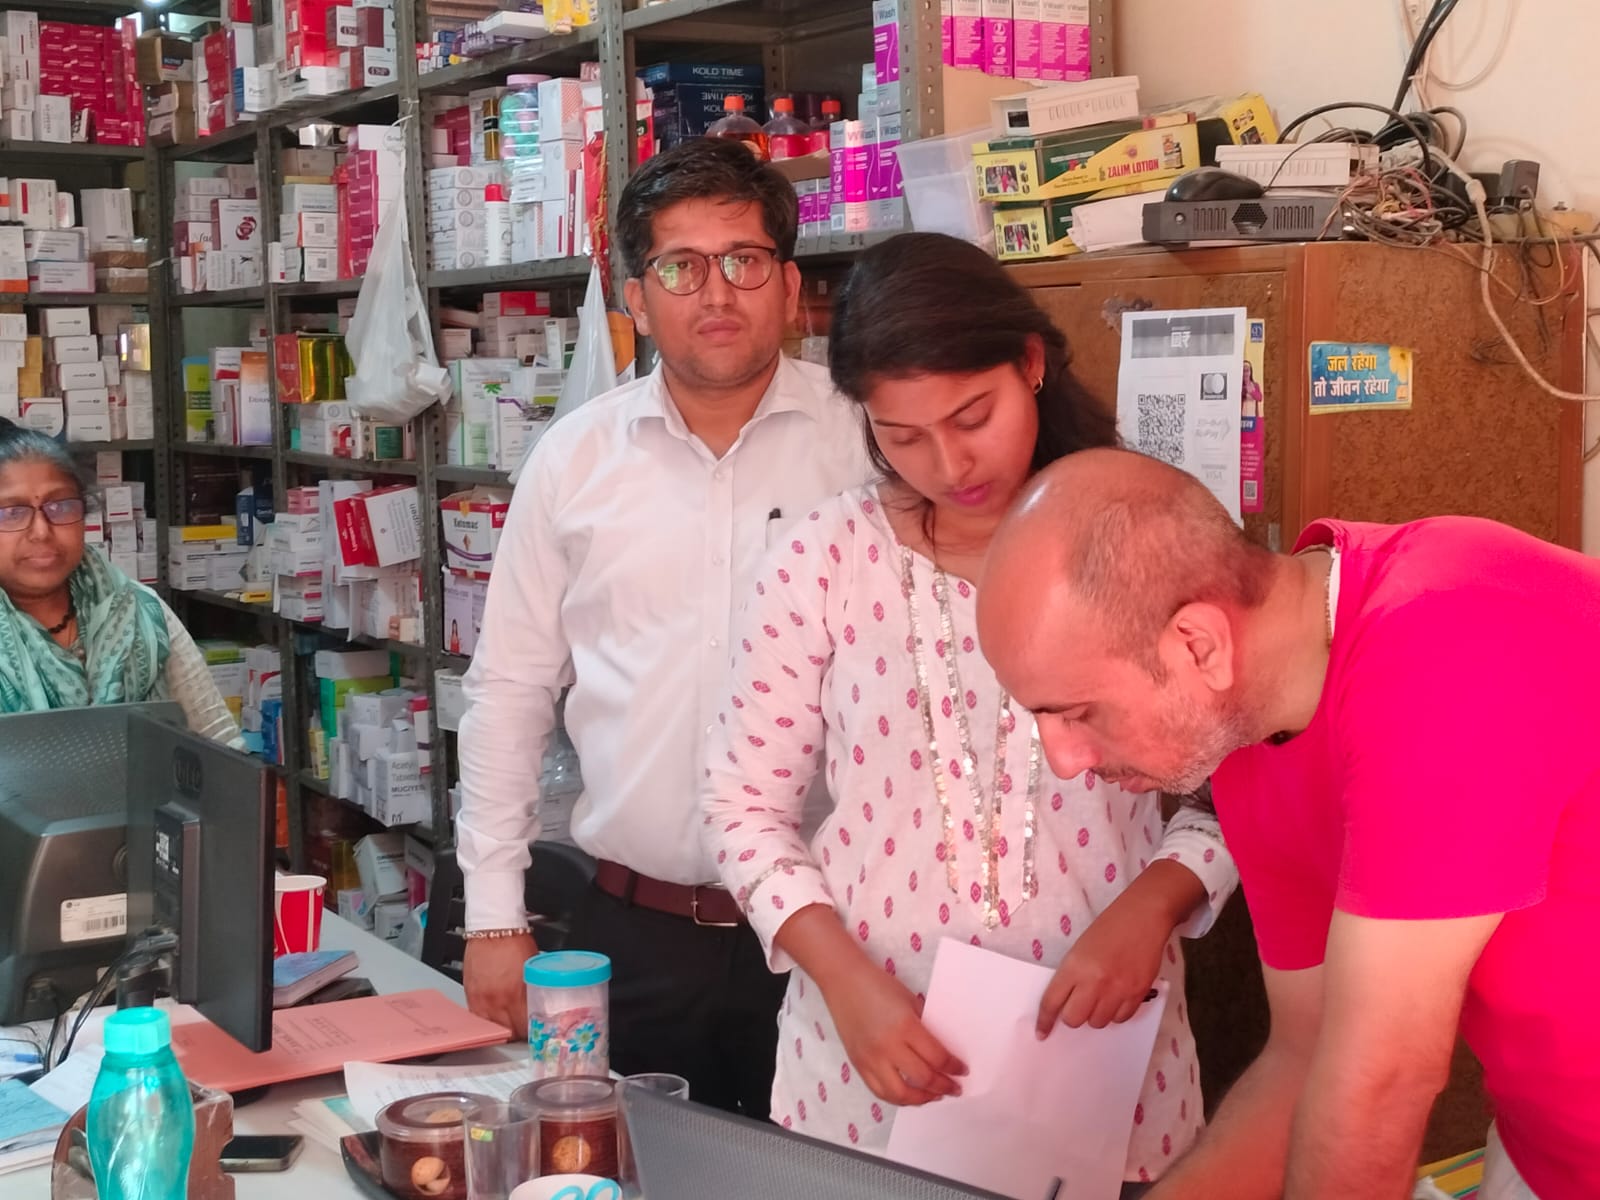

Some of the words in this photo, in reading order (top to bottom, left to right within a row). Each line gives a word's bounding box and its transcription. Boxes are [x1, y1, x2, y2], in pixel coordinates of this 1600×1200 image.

[692, 66, 719, 76] KOLD
[722, 68, 744, 76] TIME
[1108, 163, 1131, 178] ZALIM
[1132, 159, 1159, 173] LOTION
[1327, 354, 1348, 372] जल
[1351, 351, 1377, 371] रहेगा
[1313, 377, 1327, 398] तो
[1329, 376, 1361, 397] जीवन
[1363, 375, 1390, 396] रहेगा
